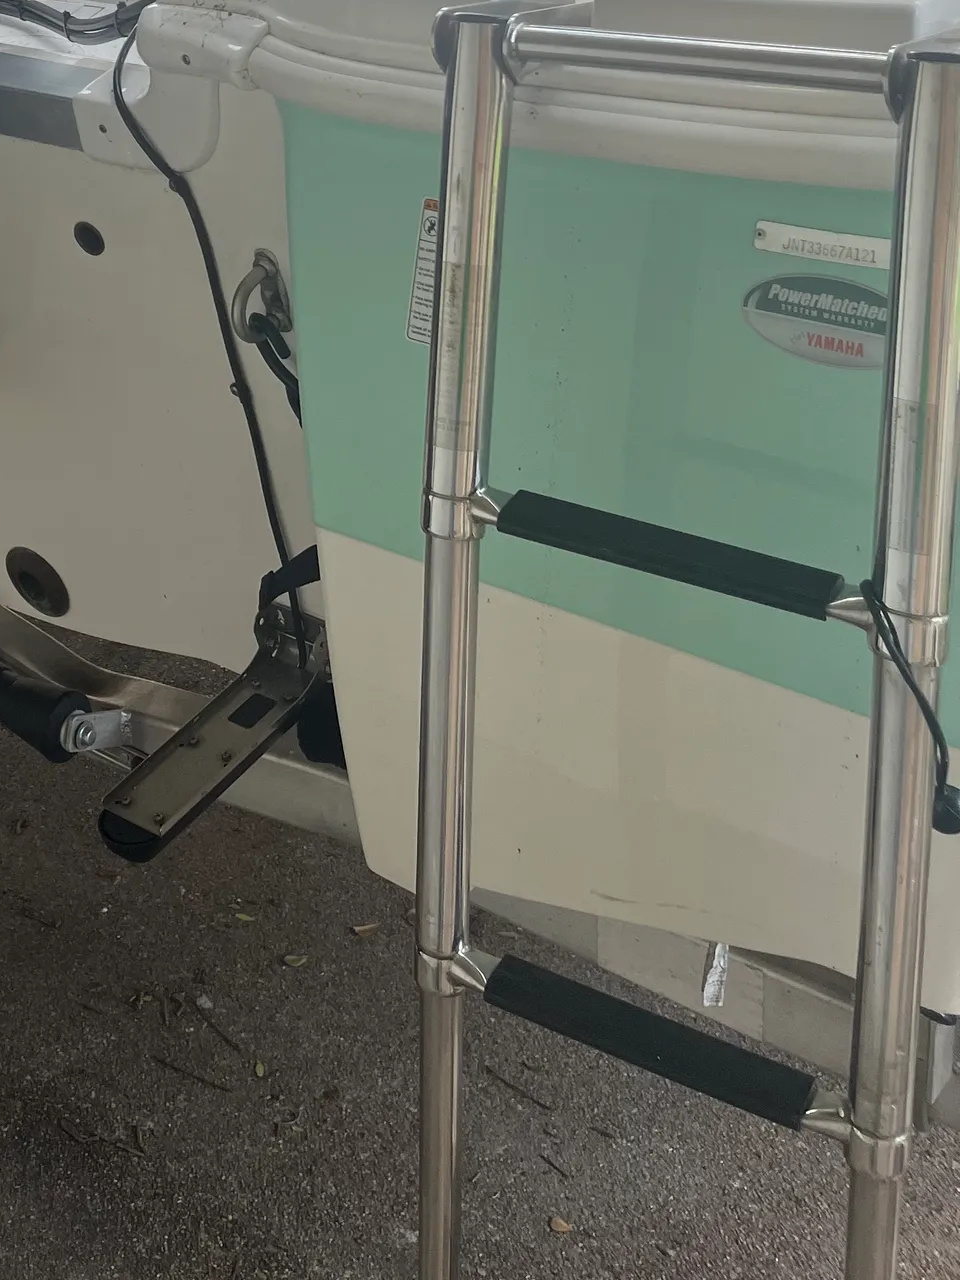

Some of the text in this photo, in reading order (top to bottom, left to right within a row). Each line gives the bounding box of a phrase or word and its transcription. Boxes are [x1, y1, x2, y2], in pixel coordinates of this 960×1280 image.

[767, 283, 888, 322] PowerMatched
[781, 303, 876, 329] SYSTEM WARRANTY
[806, 332, 865, 358] YAMAHA
